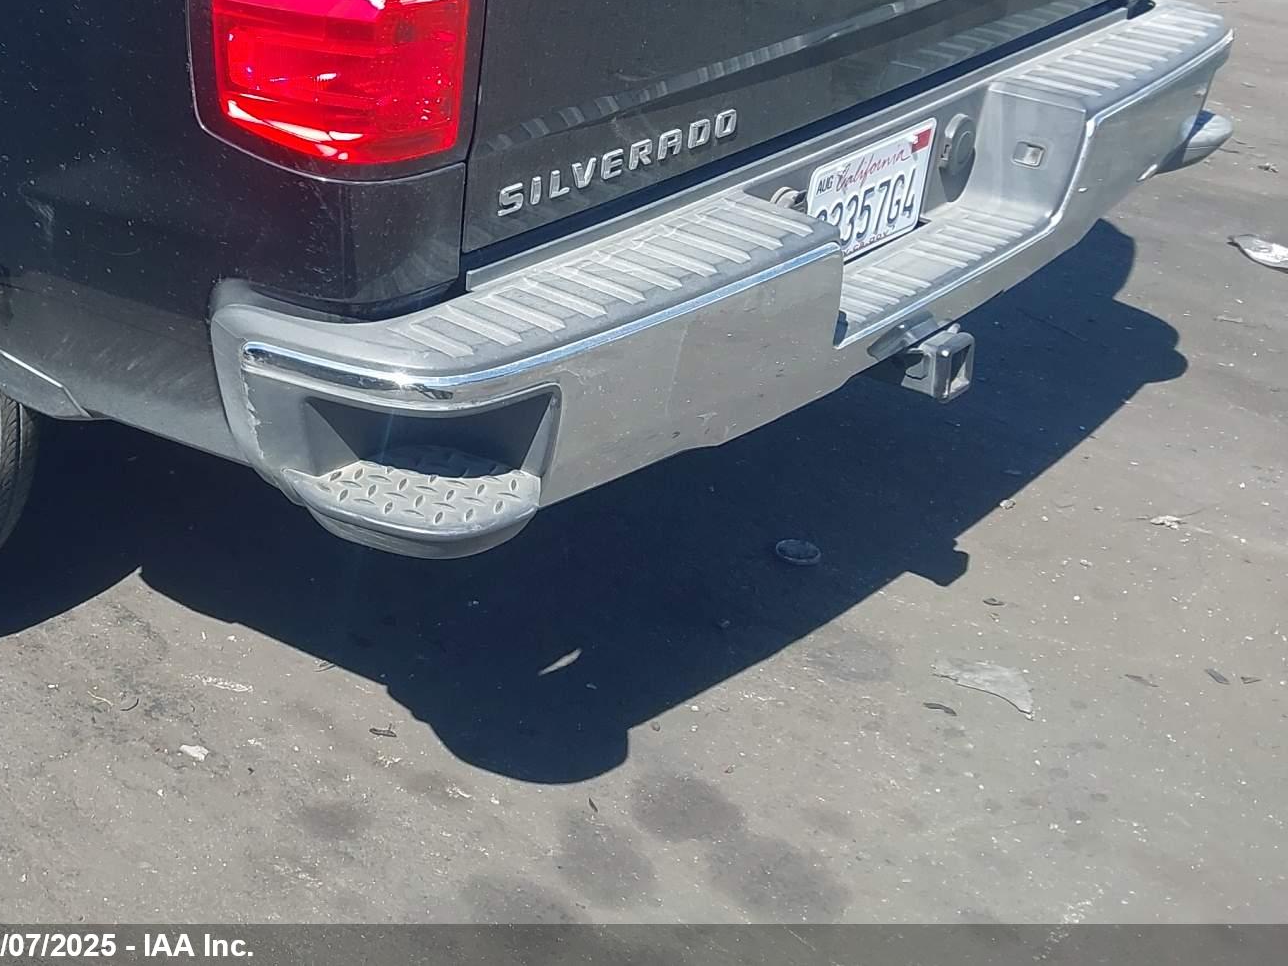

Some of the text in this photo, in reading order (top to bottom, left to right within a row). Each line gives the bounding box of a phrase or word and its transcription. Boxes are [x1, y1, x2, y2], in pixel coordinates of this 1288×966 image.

[497, 108, 737, 217] SILVERADO
[816, 147, 911, 196] AUG California
